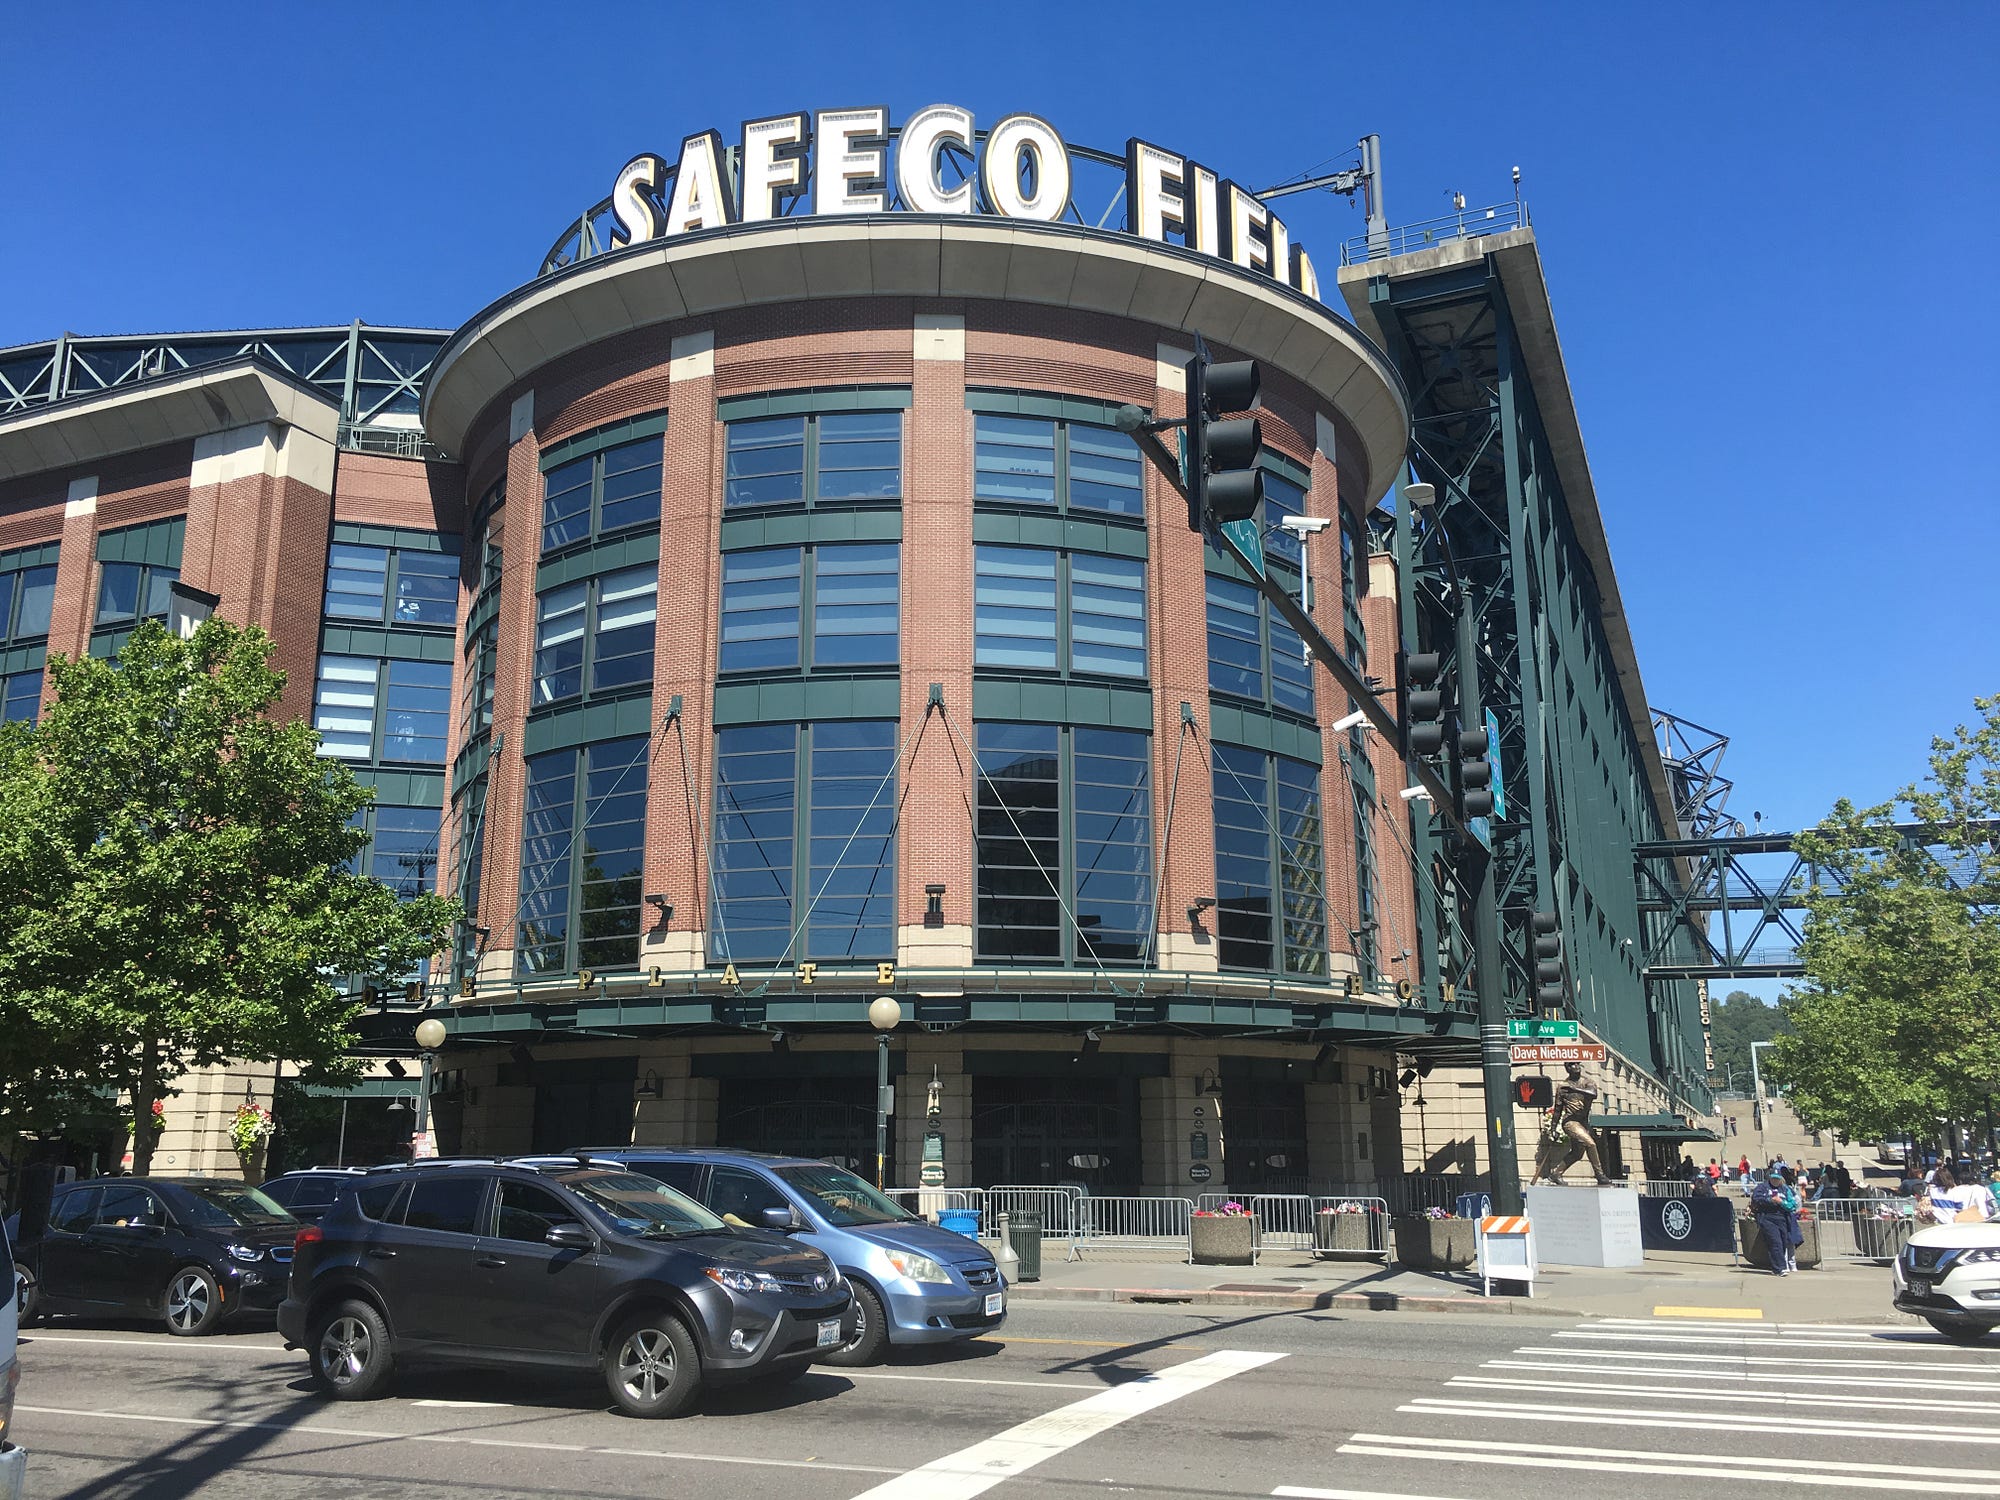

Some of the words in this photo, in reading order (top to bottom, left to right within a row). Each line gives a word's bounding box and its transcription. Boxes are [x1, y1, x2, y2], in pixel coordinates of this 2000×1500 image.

[610, 104, 1072, 250] SAFECO
[578, 963, 895, 990] PLATE
[1514, 1022, 1527, 1035] 1st
[1538, 1025, 1555, 1034] Ave
[1568, 1025, 1575, 1034] S
[1514, 1046, 1538, 1060] Dave
[1540, 1046, 1579, 1059] Niehaus
[1582, 1050, 1594, 1060] Wy
[1597, 1050, 1603, 1058] S
[1703, 1031, 1715, 1071] FIELD
